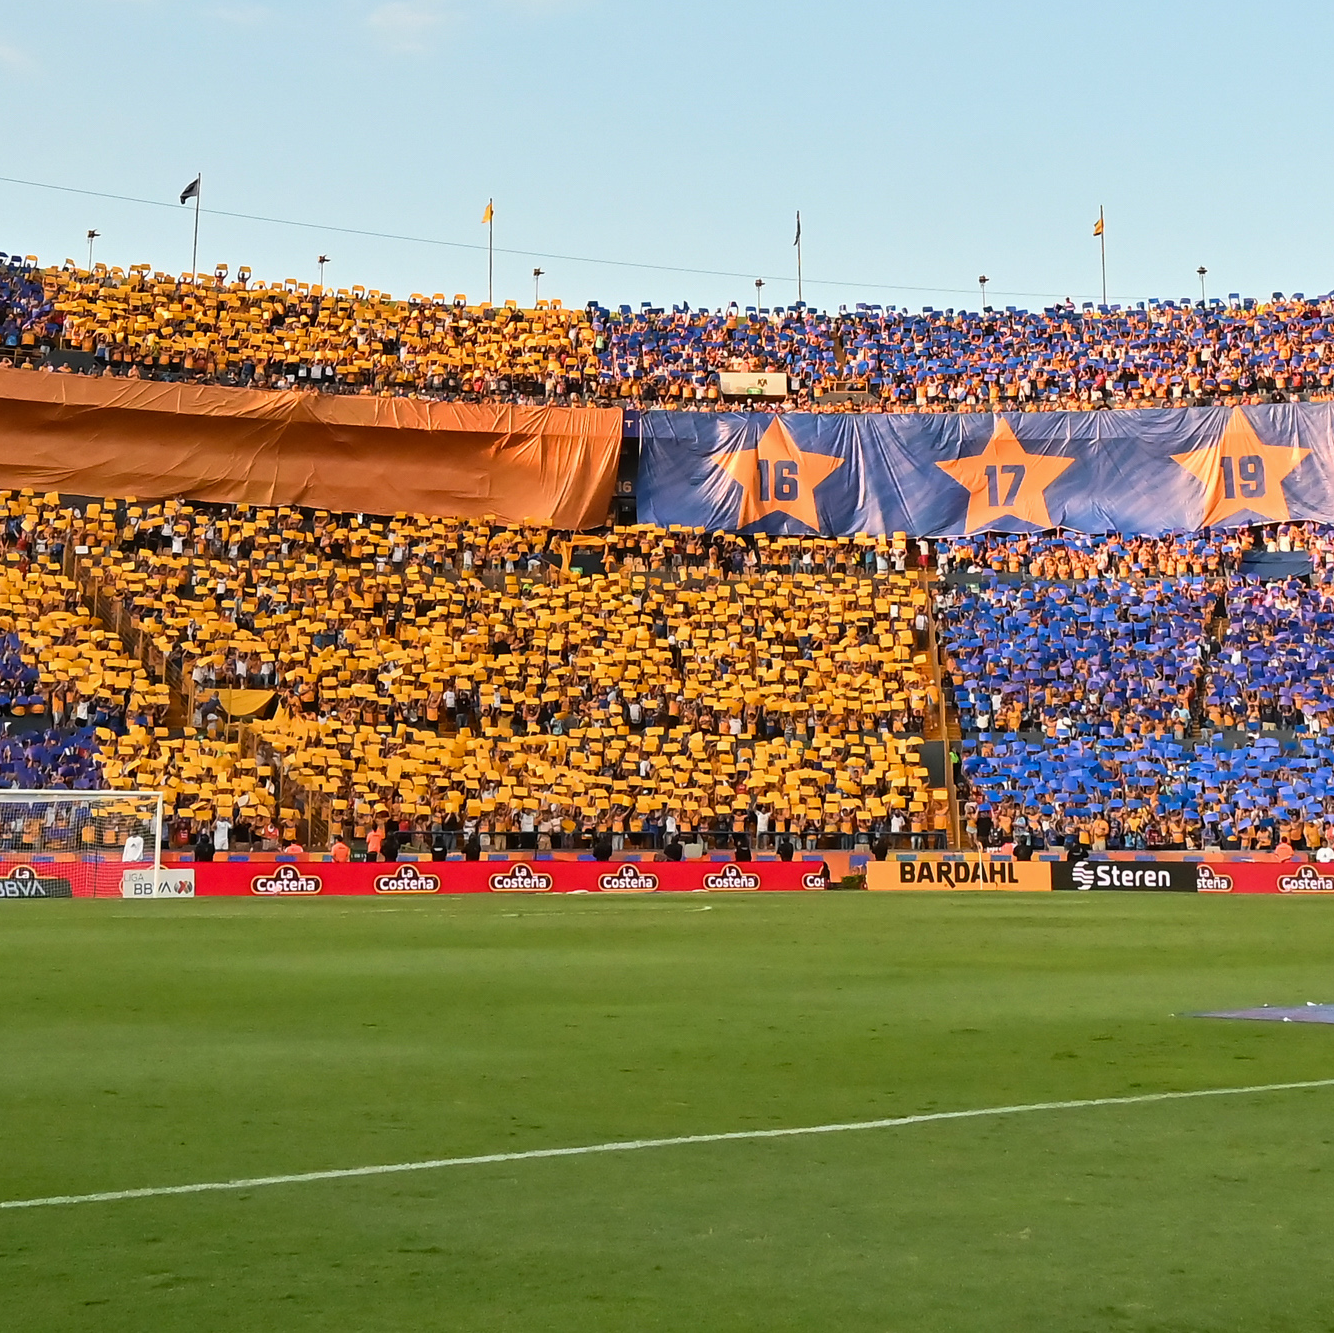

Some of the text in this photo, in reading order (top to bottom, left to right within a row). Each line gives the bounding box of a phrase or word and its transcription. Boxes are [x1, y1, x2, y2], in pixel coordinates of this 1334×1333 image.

[757, 460, 798, 501] 16
[1220, 455, 1266, 499] 19
[985, 464, 1025, 506] 17
[16, 868, 30, 879] La
[280, 869, 293, 878] La
[401, 868, 413, 877] La
[515, 867, 527, 876] La
[623, 868, 634, 876] La
[726, 867, 737, 876] La
[900, 862, 1019, 888] BARDAHL
[1097, 865, 1170, 887] Steren
[1199, 868, 1210, 877] La
[1301, 868, 1313, 878] La
[257, 878, 315, 891] Costeña
[380, 876, 434, 890] Costeña
[494, 876, 547, 888] Costeña
[603, 876, 653, 888] Costeña
[707, 876, 755, 888] Costeña
[1282, 876, 1333, 890] Costeña
